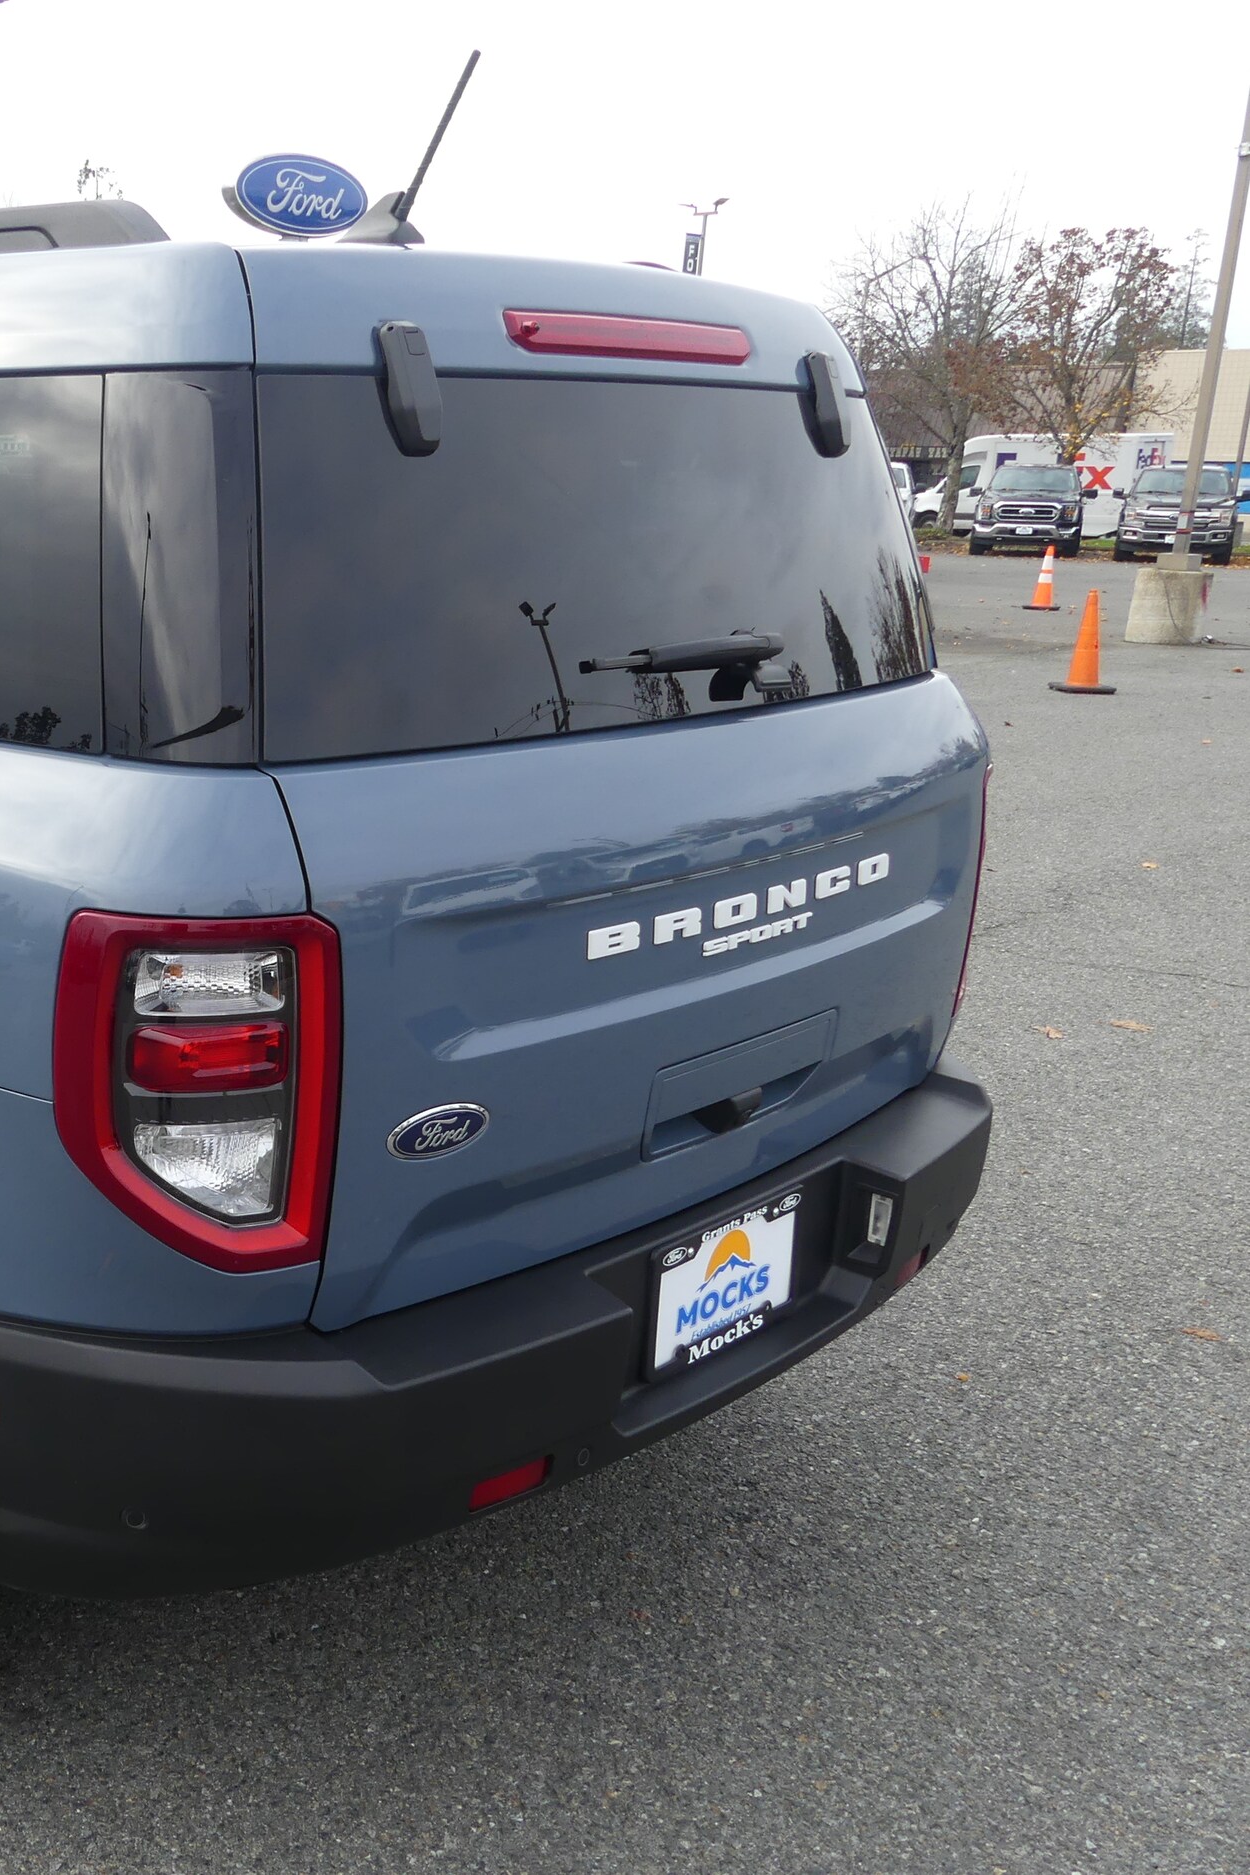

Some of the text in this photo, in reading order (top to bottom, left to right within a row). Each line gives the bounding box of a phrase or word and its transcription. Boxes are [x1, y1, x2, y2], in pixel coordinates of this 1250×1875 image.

[266, 167, 345, 221] Ford
[586, 852, 890, 961] BRONCO
[701, 911, 814, 957] SPORT
[414, 1116, 471, 1151] Ford
[701, 1205, 768, 1244] Grants Pass
[674, 1263, 771, 1336] MOCKS
[687, 1313, 764, 1365] Mock's
